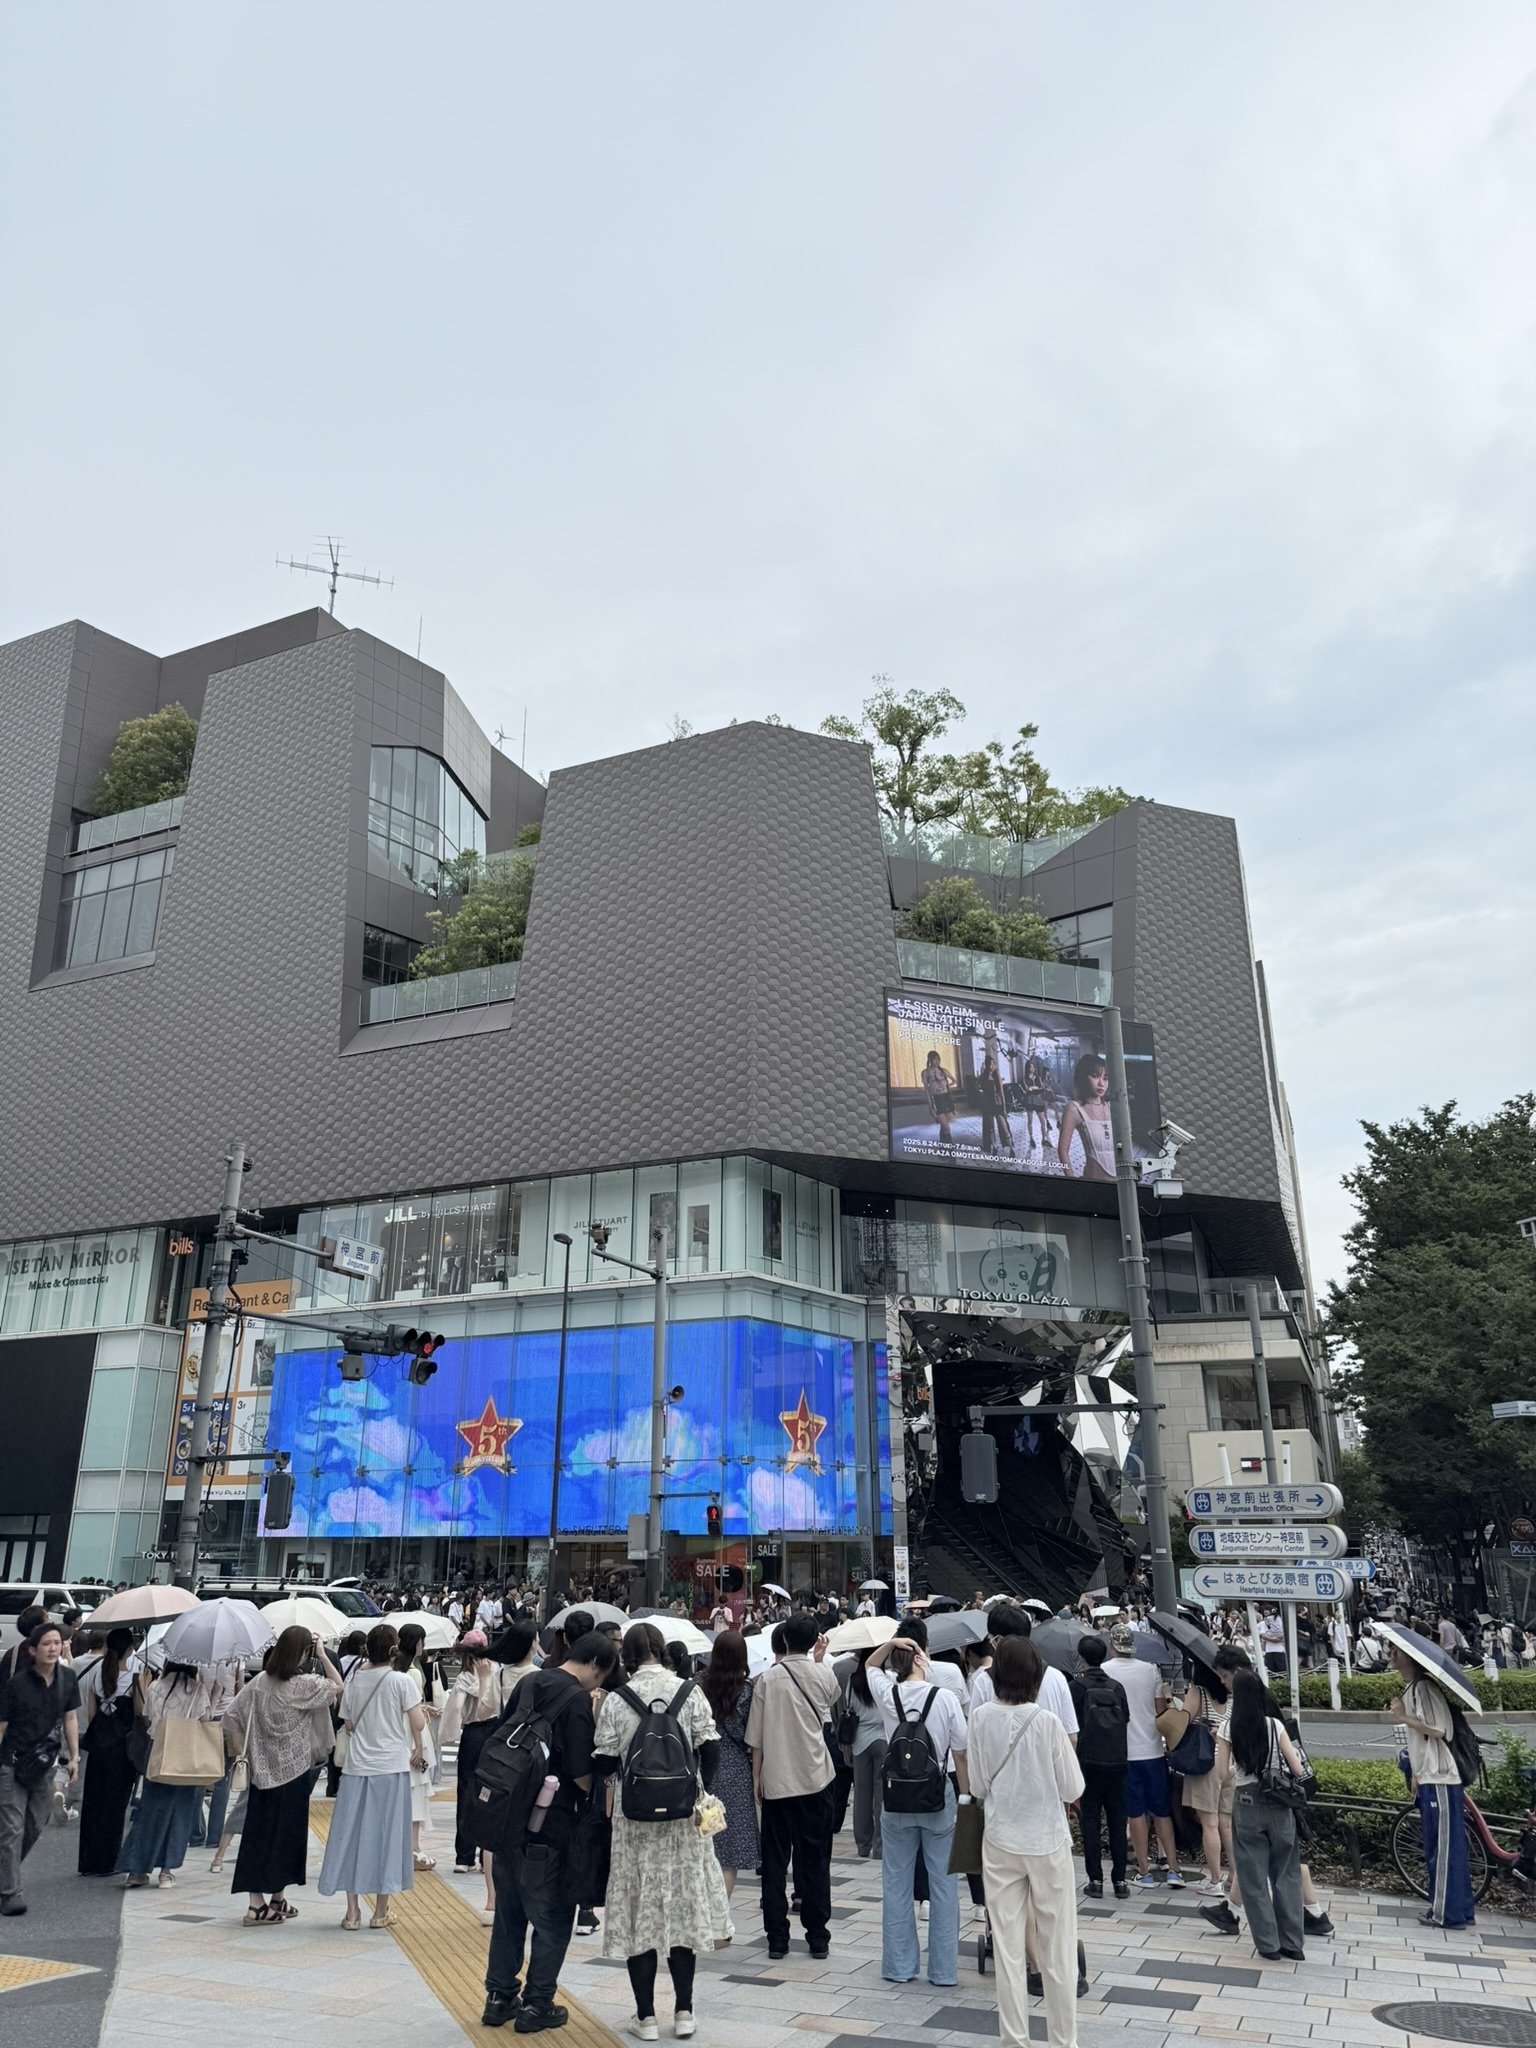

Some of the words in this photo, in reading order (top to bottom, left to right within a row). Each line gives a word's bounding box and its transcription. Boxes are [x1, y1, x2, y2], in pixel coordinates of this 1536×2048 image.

[913, 1001, 973, 1017] SSERAFIM
[898, 1009, 937, 1022] JAPAN
[939, 1014, 963, 1026] 4TH
[965, 1018, 1006, 1031] SINGLE
[931, 1034, 961, 1046] STORE
[903, 1146, 927, 1155] TOKYU
[928, 1148, 950, 1158] PLAZA
[384, 1206, 417, 1223] JILL
[421, 1211, 432, 1219] by
[169, 1237, 194, 1256] bills
[341, 1241, 380, 1265] 神宮前
[4, 1254, 64, 1276] ISETAN
[28, 1280, 52, 1290] Make
[53, 1278, 61, 1288] &
[62, 1274, 109, 1287] Cosmetics
[261, 1292, 270, 1305] &
[958, 1288, 1013, 1302] TOKYU
[1017, 1292, 1071, 1306] PLAZA
[1216, 1490, 1300, 1505] 神宮前出張所
[1223, 1505, 1251, 1514] Jingumae
[1253, 1505, 1274, 1513] Branch
[1275, 1504, 1295, 1512] Office
[1219, 1531, 1304, 1544] 地域交流センター神宮前
[757, 1544, 777, 1556] SALE
[1221, 1545, 1249, 1553] Jingumae
[1249, 1545, 1283, 1553] Community
[1284, 1544, 1305, 1552] Center
[696, 1564, 730, 1577] SALE
[851, 1571, 868, 1583] SALE
[1240, 1586, 1265, 1594] Heartpia
[1266, 1586, 1294, 1595] Harajuku
